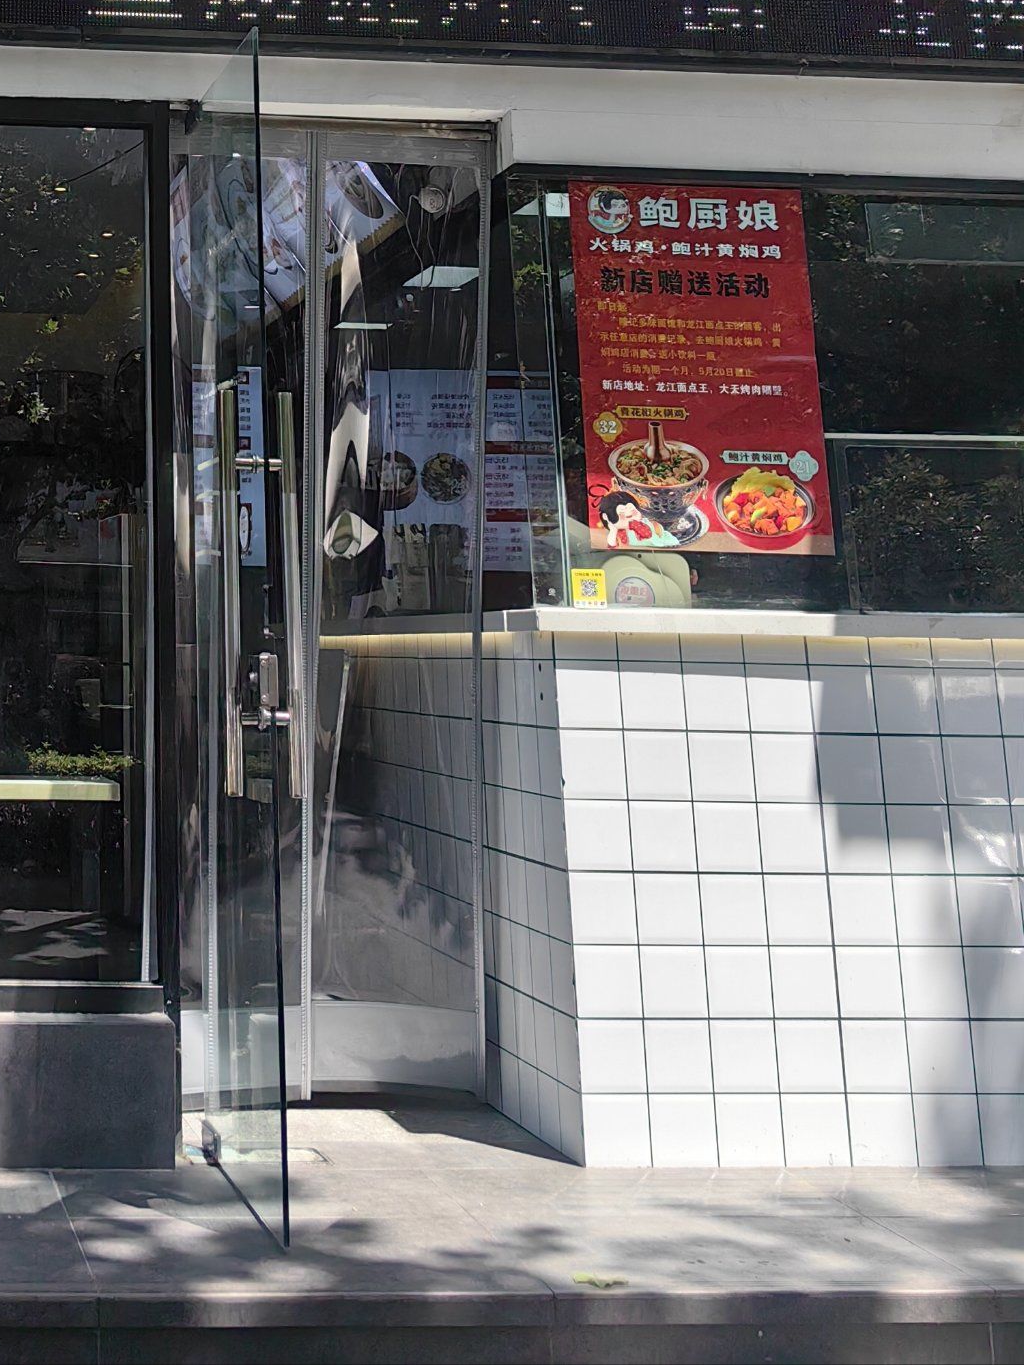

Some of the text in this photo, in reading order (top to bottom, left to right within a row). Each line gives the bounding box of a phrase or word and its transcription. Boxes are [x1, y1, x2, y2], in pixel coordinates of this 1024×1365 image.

[638, 195, 780, 231] 鲍厨娘
[599, 266, 771, 298] 新店赠送活动
[599, 420, 618, 435] 32
[728, 451, 784, 464] 鲍汁黄焖鸡
[796, 460, 811, 474] 21
